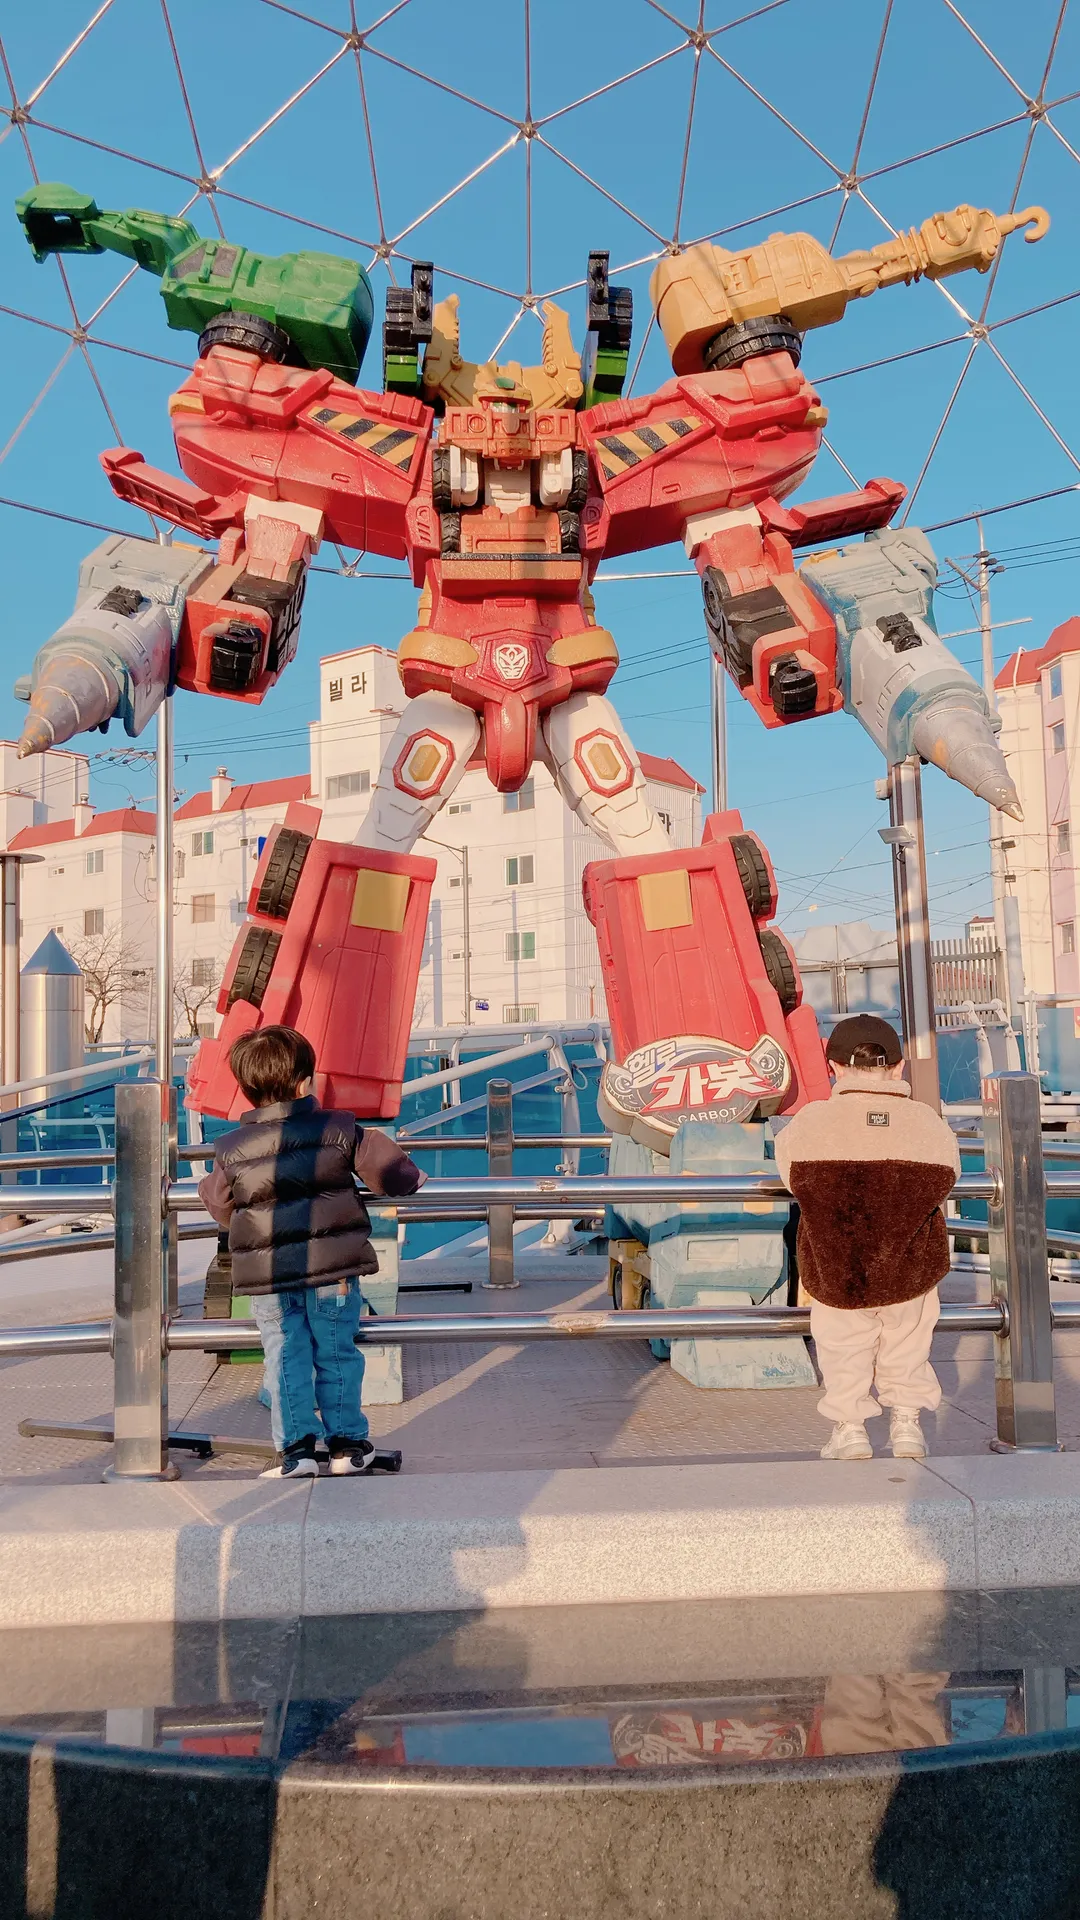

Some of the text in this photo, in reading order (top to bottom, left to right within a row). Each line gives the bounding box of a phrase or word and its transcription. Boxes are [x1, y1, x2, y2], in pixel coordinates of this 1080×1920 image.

[627, 1040, 677, 1088] 헬로
[649, 1059, 774, 1109] 카봇
[677, 1107, 738, 1124] CARBOT
